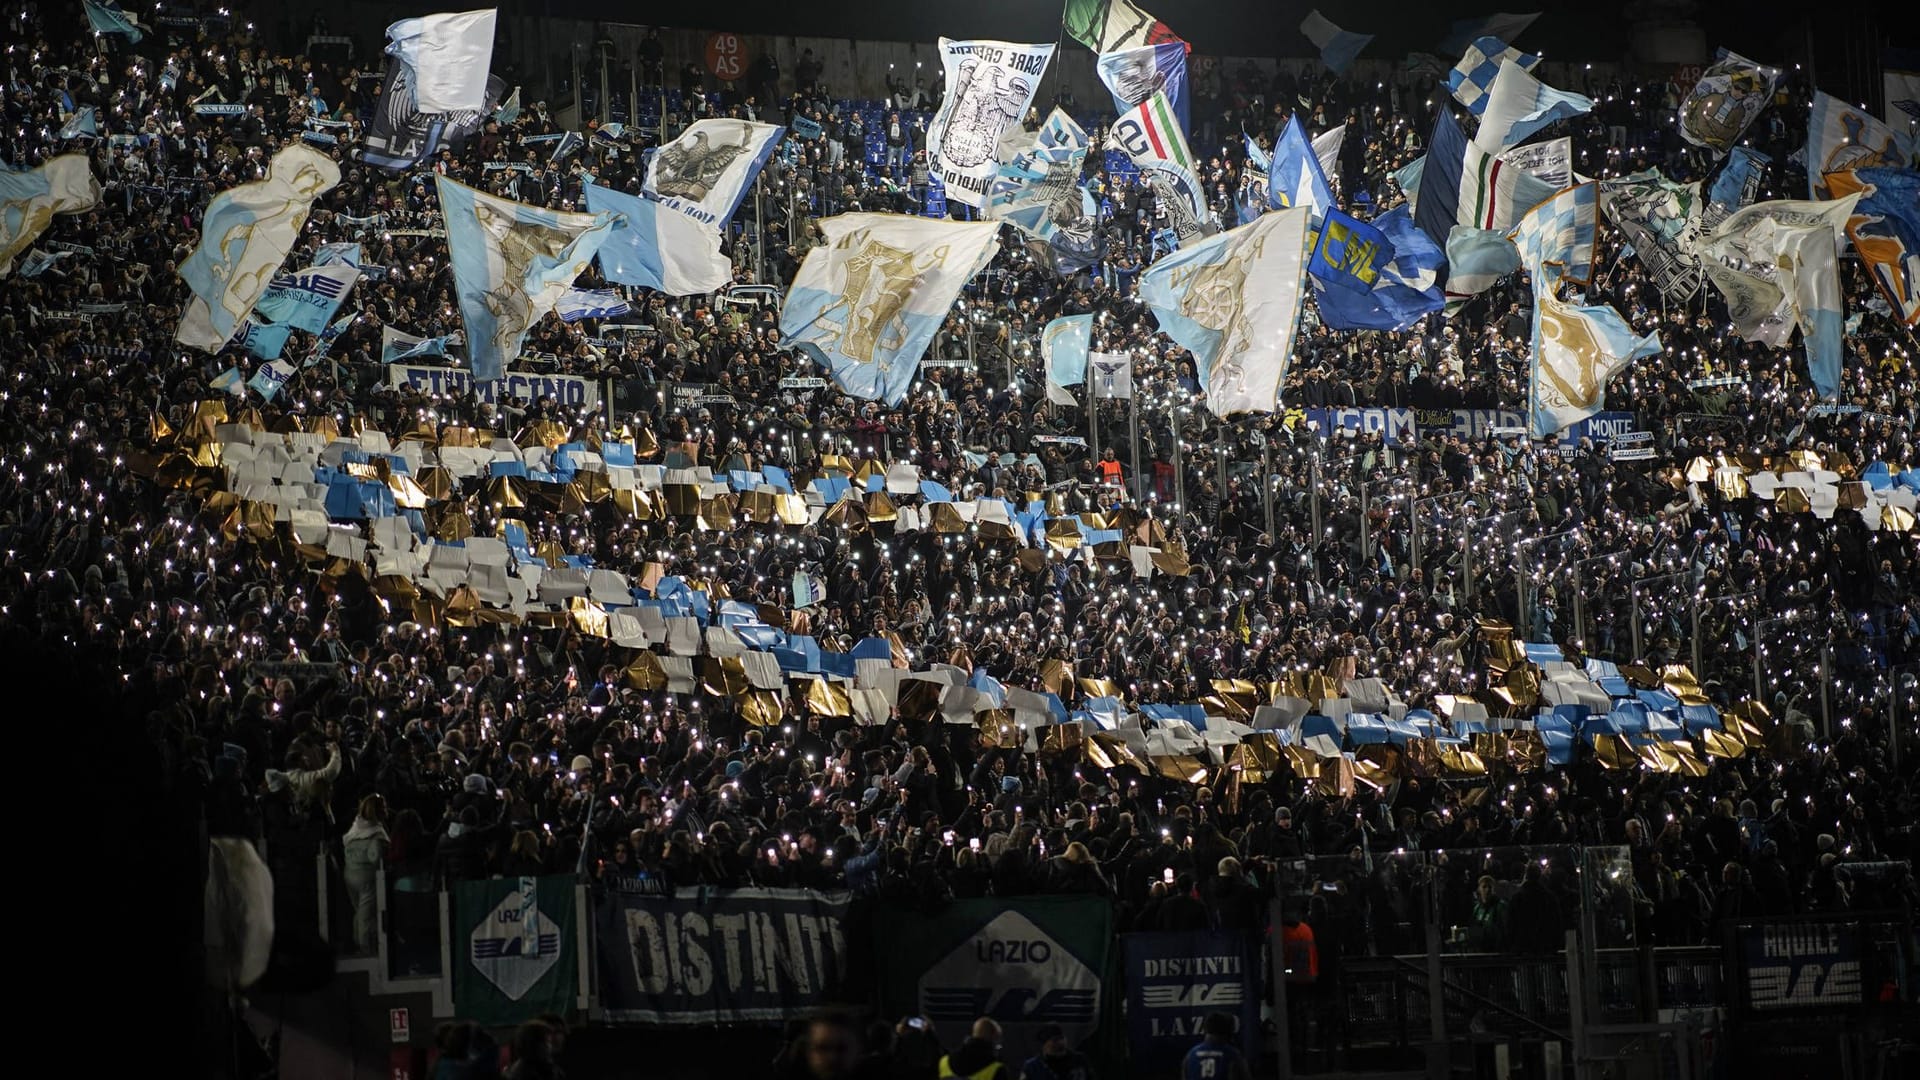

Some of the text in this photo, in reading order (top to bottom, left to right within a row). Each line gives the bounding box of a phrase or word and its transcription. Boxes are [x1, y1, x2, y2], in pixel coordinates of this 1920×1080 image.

[715, 36, 738, 54] 49
[715, 55, 739, 74] AS
[1322, 220, 1380, 285] CML
[673, 386, 704, 398] CANNONE
[1588, 419, 1633, 437] MONTE
[498, 909, 521, 923] LAZ
[976, 940, 1051, 963] LAZIO
[1144, 956, 1240, 977] DISTINTI
